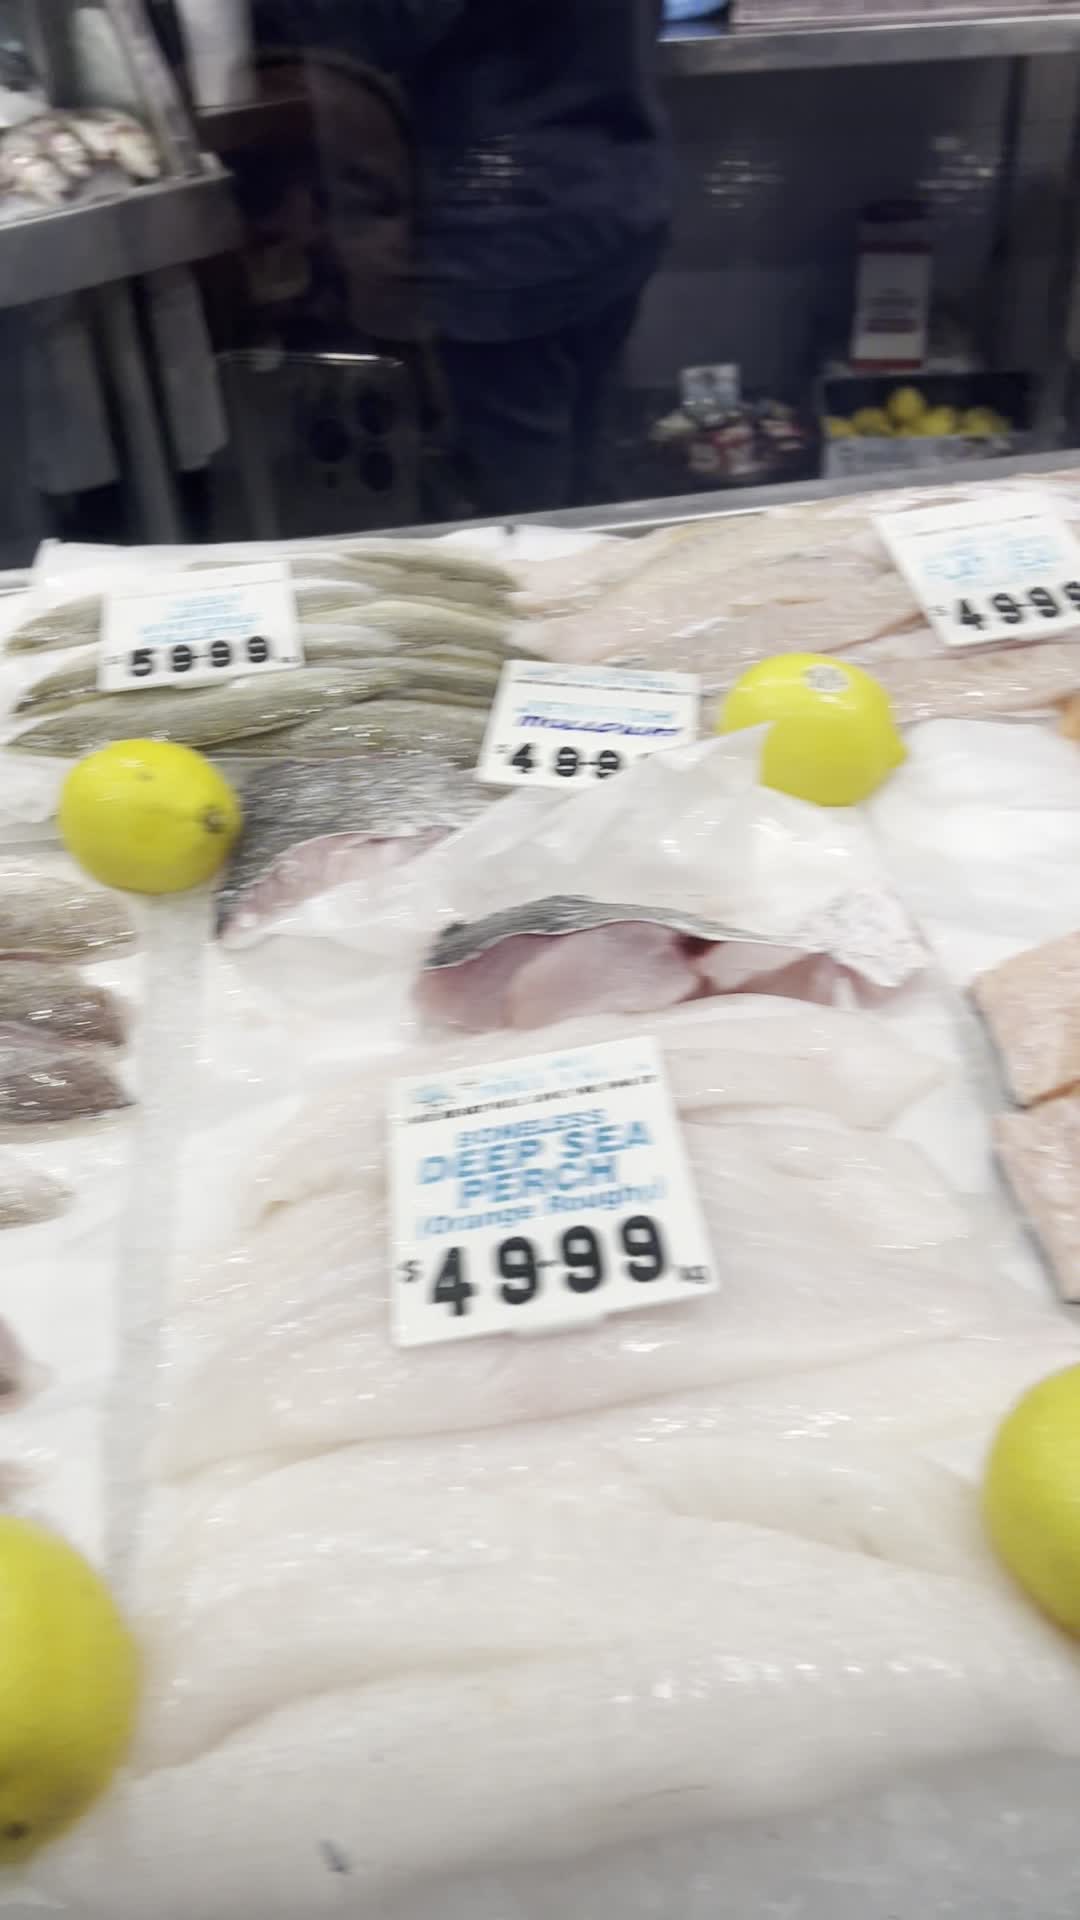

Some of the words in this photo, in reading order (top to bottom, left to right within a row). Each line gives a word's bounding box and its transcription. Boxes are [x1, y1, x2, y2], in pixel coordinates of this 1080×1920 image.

[416, 1137, 543, 1185] DEEP
[560, 1119, 656, 1159] SEA
[456, 1154, 620, 1209] PERCH
